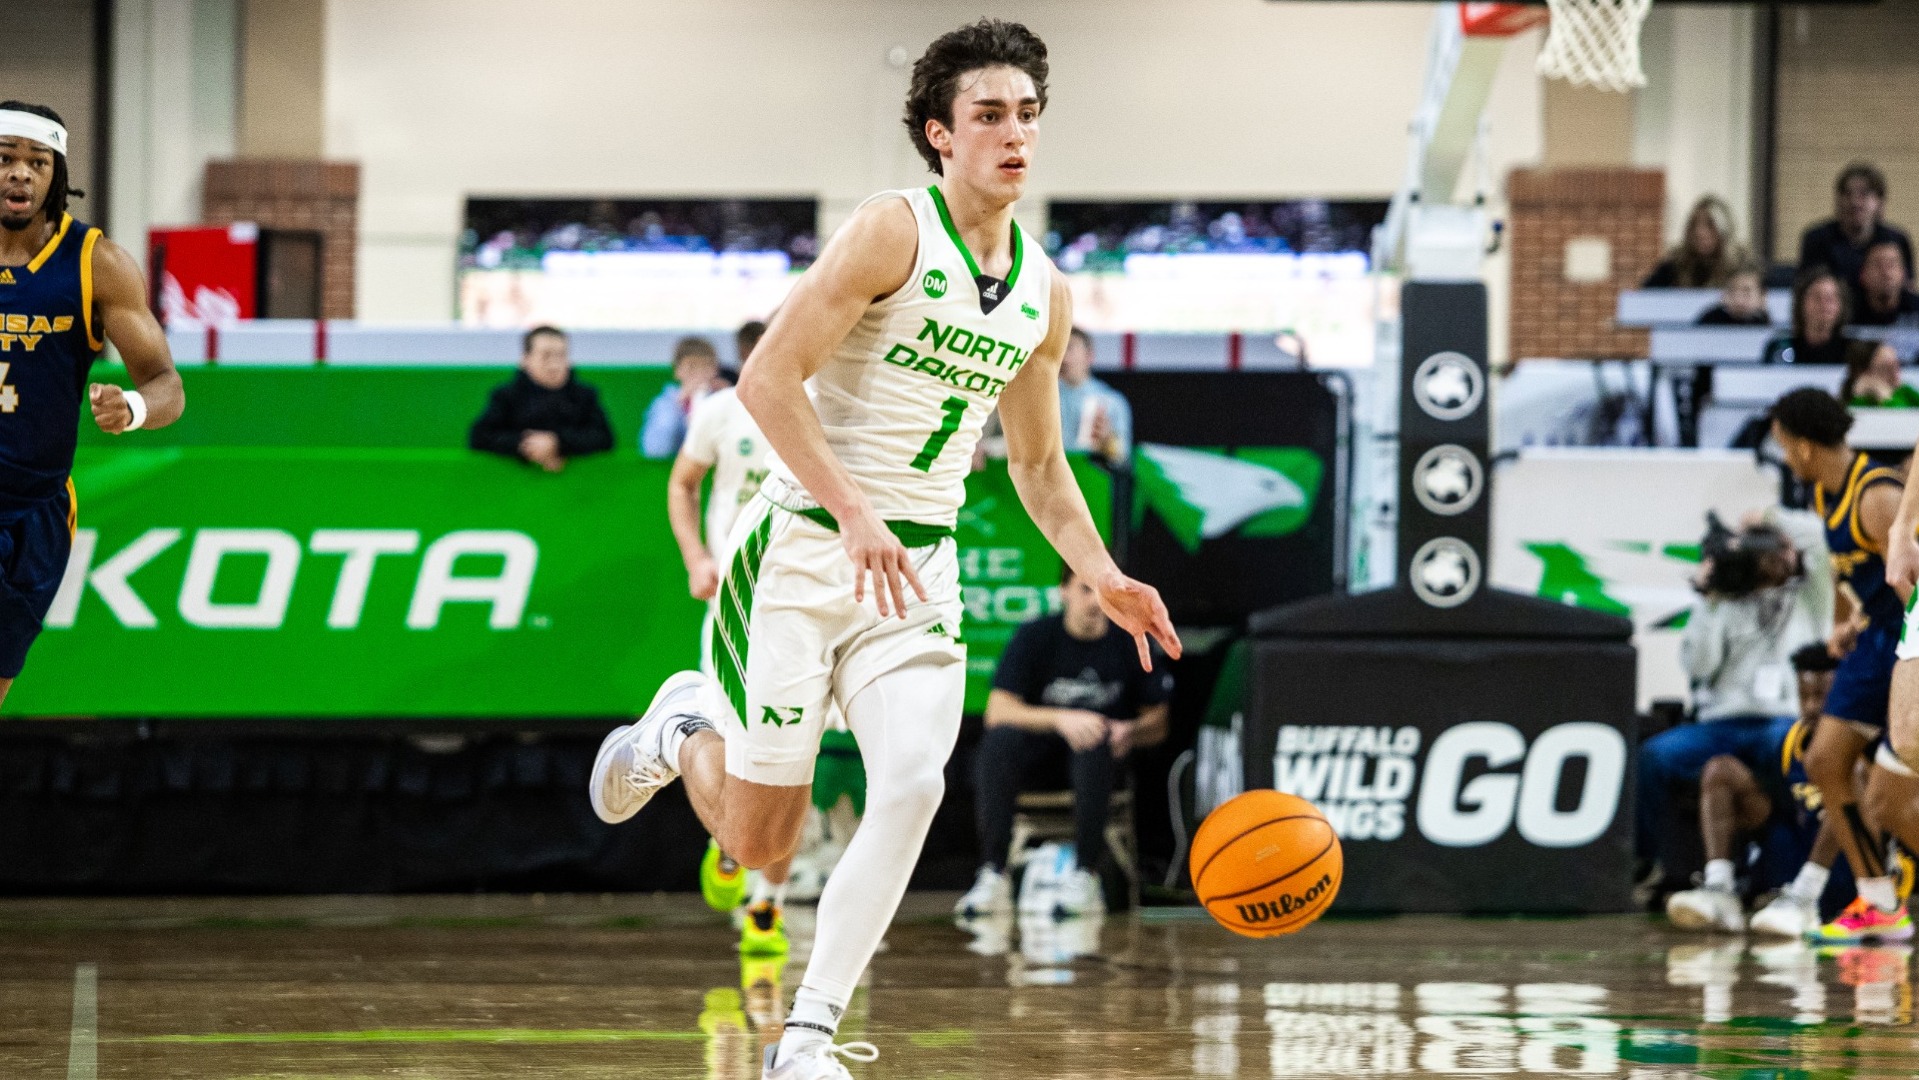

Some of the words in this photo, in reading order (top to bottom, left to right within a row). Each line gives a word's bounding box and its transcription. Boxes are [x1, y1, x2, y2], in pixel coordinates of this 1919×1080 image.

[924, 275, 947, 294] DM
[883, 343, 1007, 398] DAKOT
[916, 316, 1029, 373] NORTH
[908, 394, 969, 473] 1
[42, 527, 540, 630] KOTA
[1276, 725, 1422, 756] BUFFALO
[1273, 753, 1416, 802] WILD
[1416, 720, 1628, 848] GO
[1236, 873, 1332, 924] Wilson
